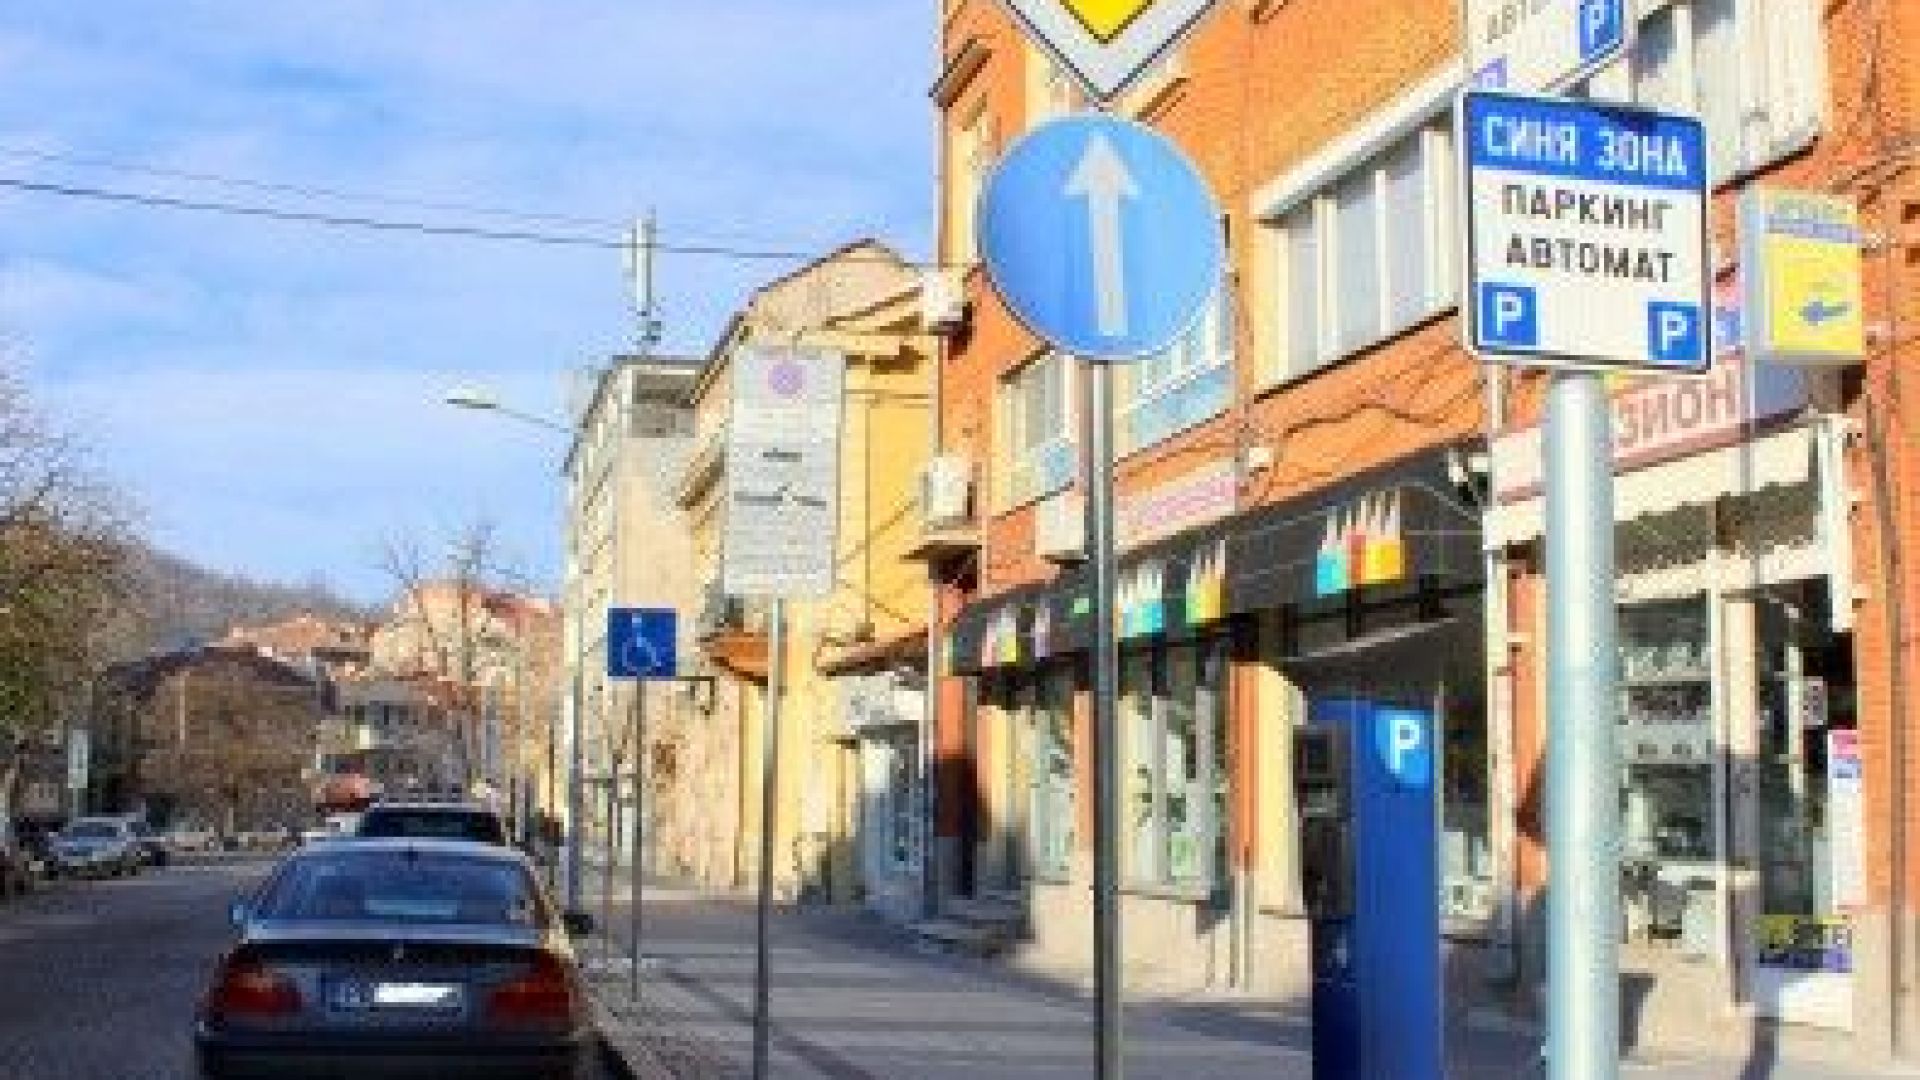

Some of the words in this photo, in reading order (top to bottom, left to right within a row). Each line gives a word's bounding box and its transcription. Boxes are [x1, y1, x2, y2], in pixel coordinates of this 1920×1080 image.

[1483, 115, 1577, 164] СИНЯ
[1599, 130, 1688, 176] ЗОНА
[1501, 185, 1670, 231] ПАРКИНГ
[1505, 234, 1674, 283] АВТОМАТ
[1496, 296, 1523, 335] P
[1661, 312, 1688, 352] P
[1388, 716, 1421, 773] P
